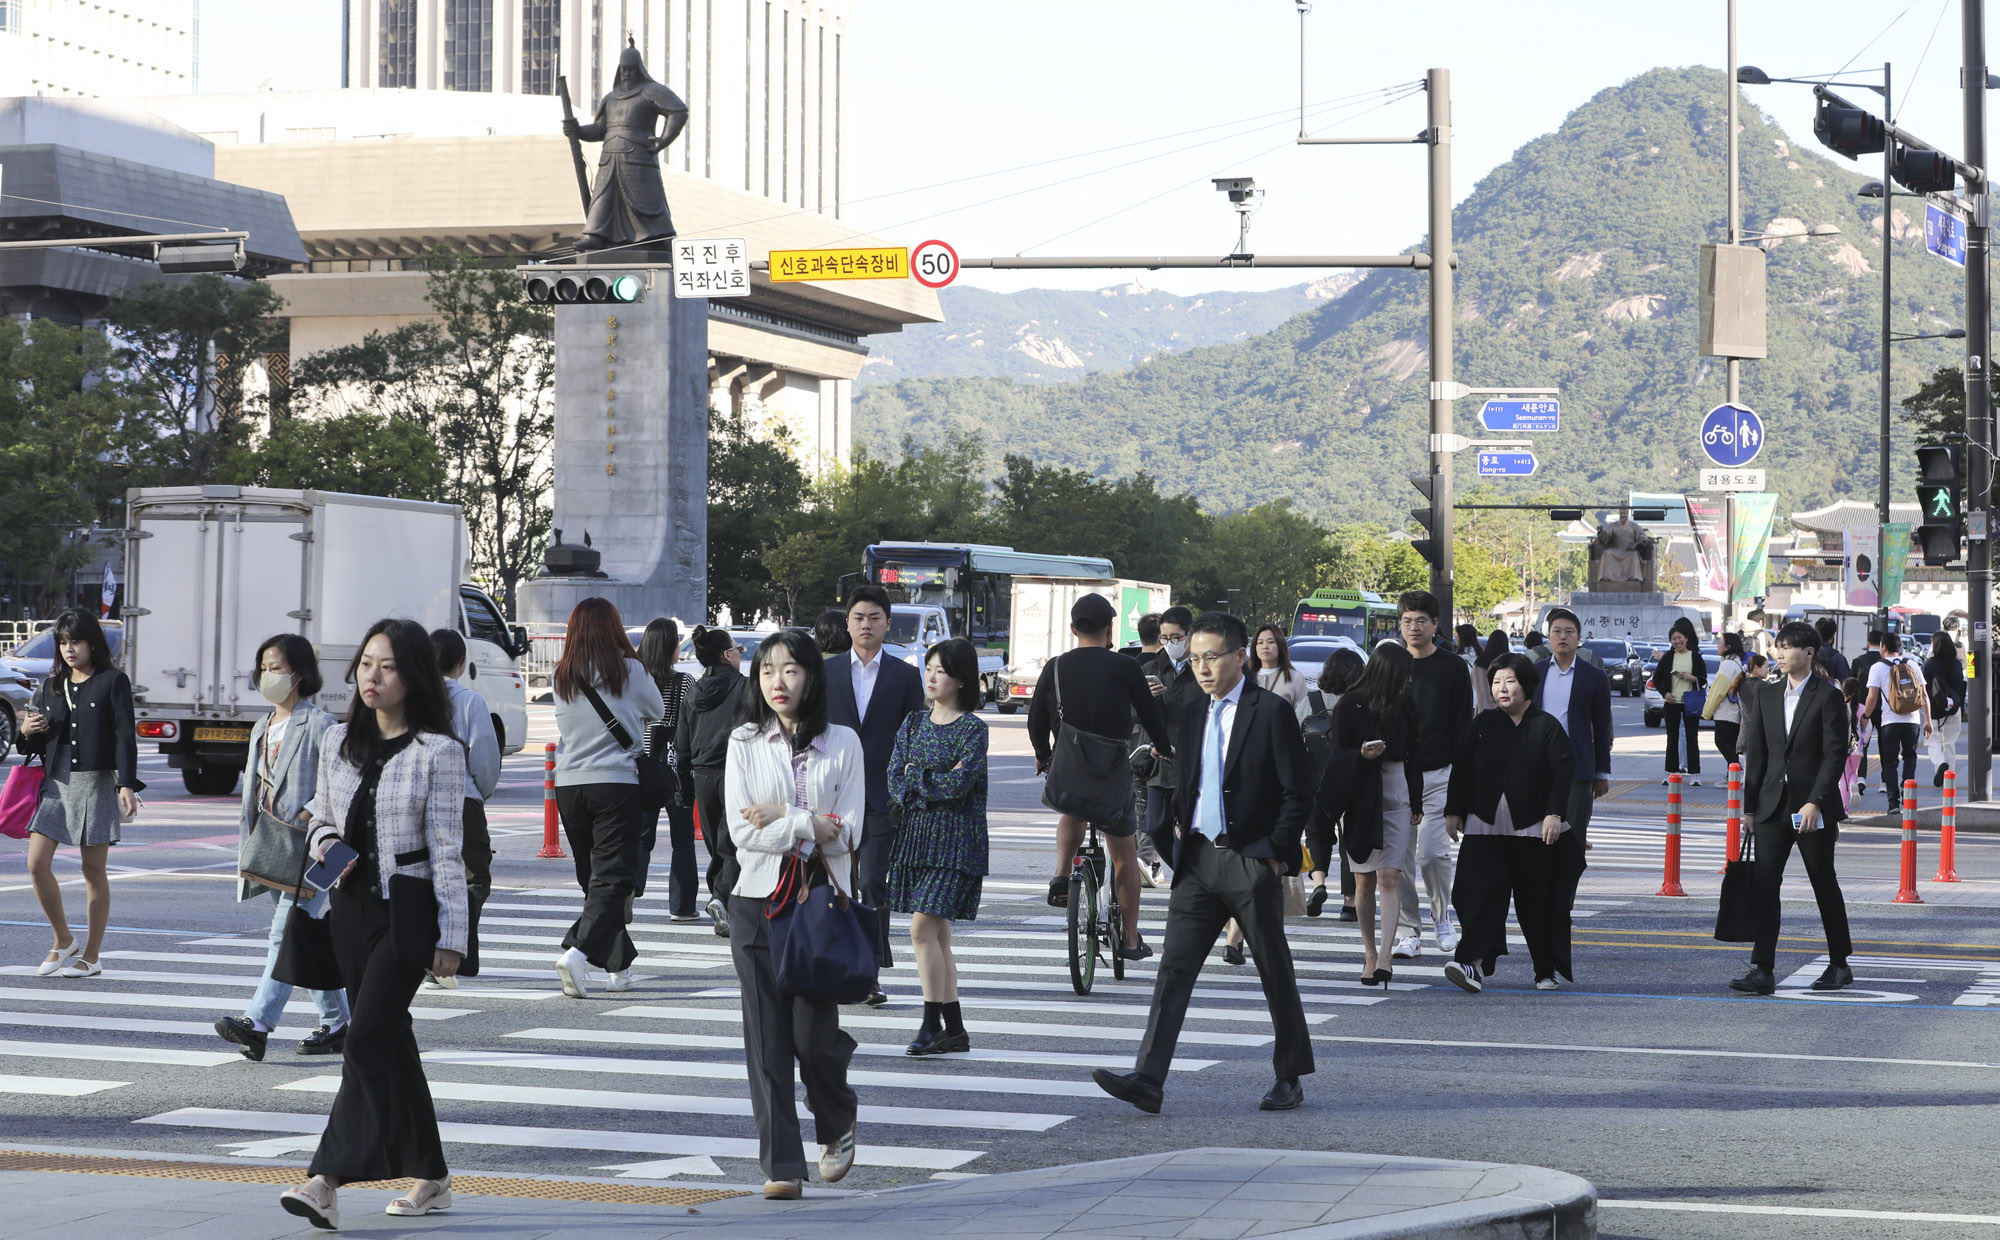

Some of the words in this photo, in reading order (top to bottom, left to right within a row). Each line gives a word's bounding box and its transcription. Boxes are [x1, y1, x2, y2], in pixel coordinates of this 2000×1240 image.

[780, 253, 899, 277] 신호과속단속장비
[921, 252, 951, 275] 50
[679, 268, 745, 291] 직좌신호
[1522, 403, 1556, 413] 새문안로
[1481, 455, 1499, 466] 종로
[1707, 474, 1758, 485] 겸용도로
[1584, 616, 1640, 628] 세종대왕
